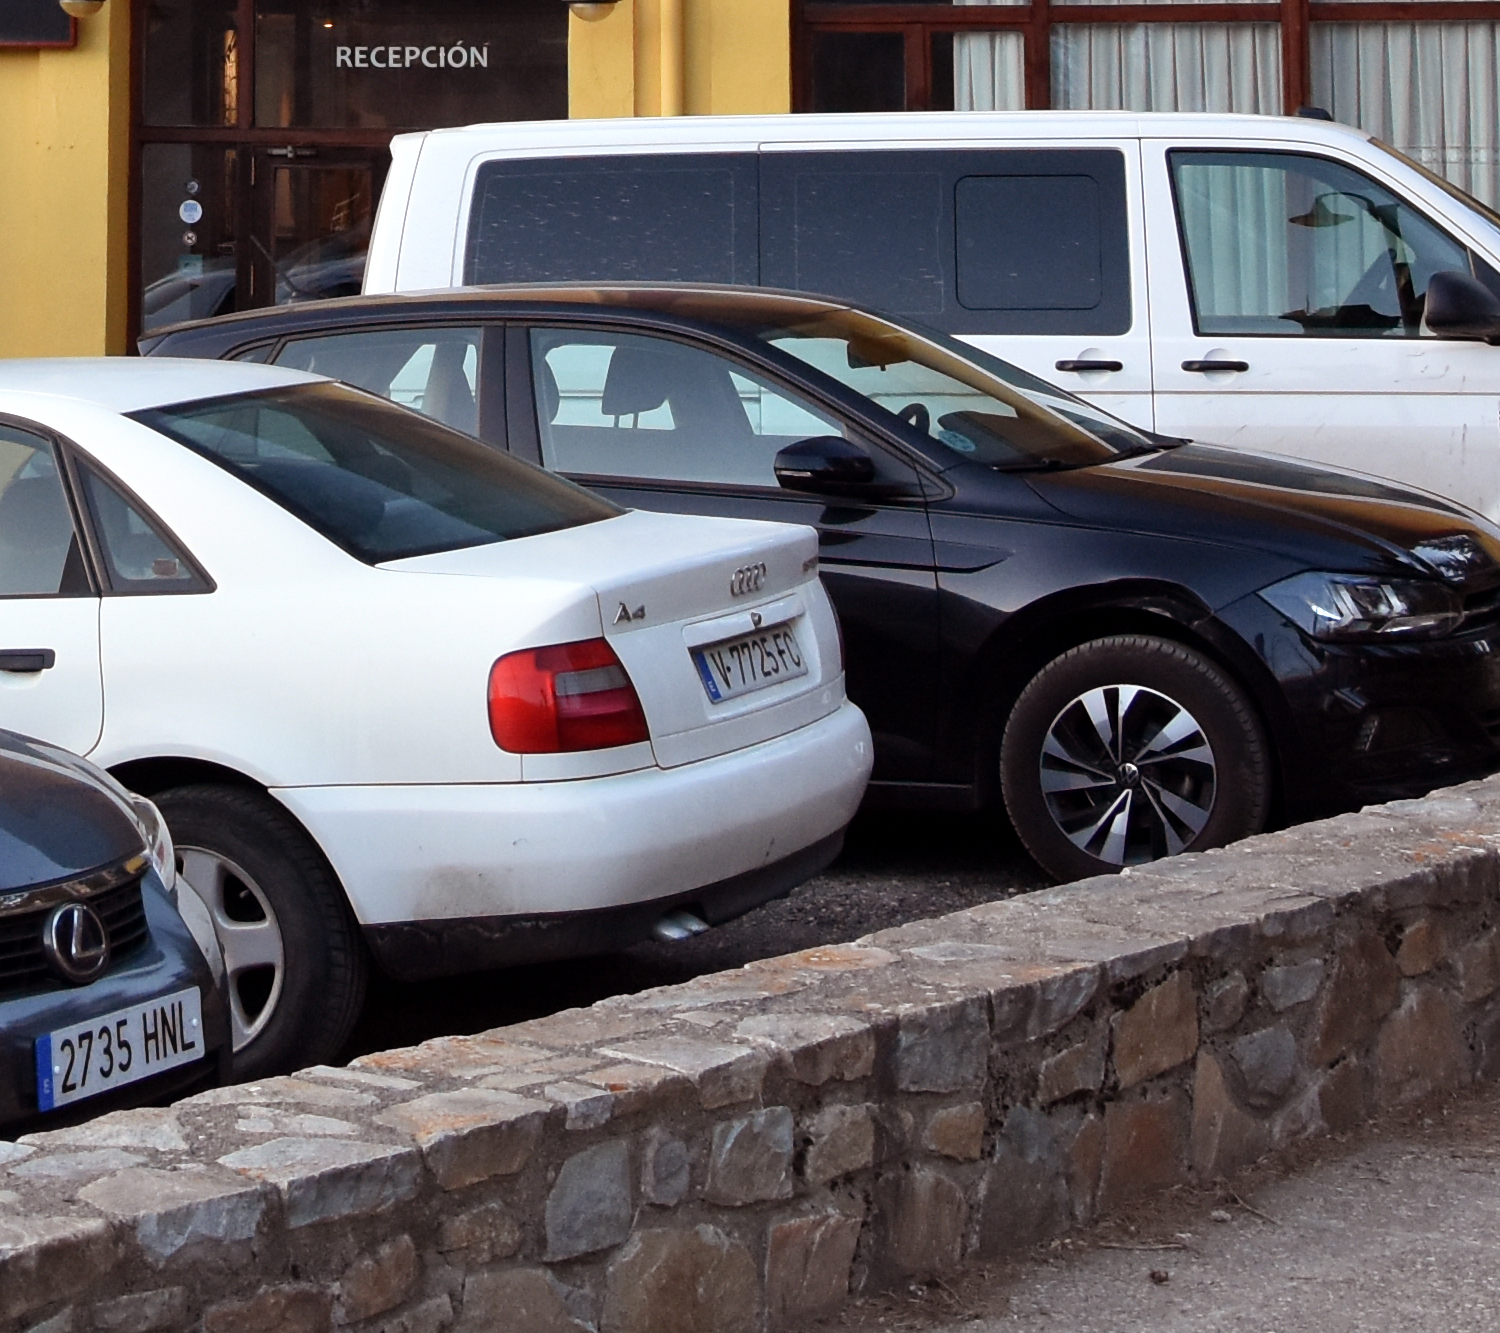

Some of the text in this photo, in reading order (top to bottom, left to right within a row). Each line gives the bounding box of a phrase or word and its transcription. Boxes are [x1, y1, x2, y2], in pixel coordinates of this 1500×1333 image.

[336, 40, 488, 68] RECEPCIÓN
[612, 602, 646, 625] A4
[60, 1018, 132, 1093] 2735
[142, 1001, 196, 1064] HNL
